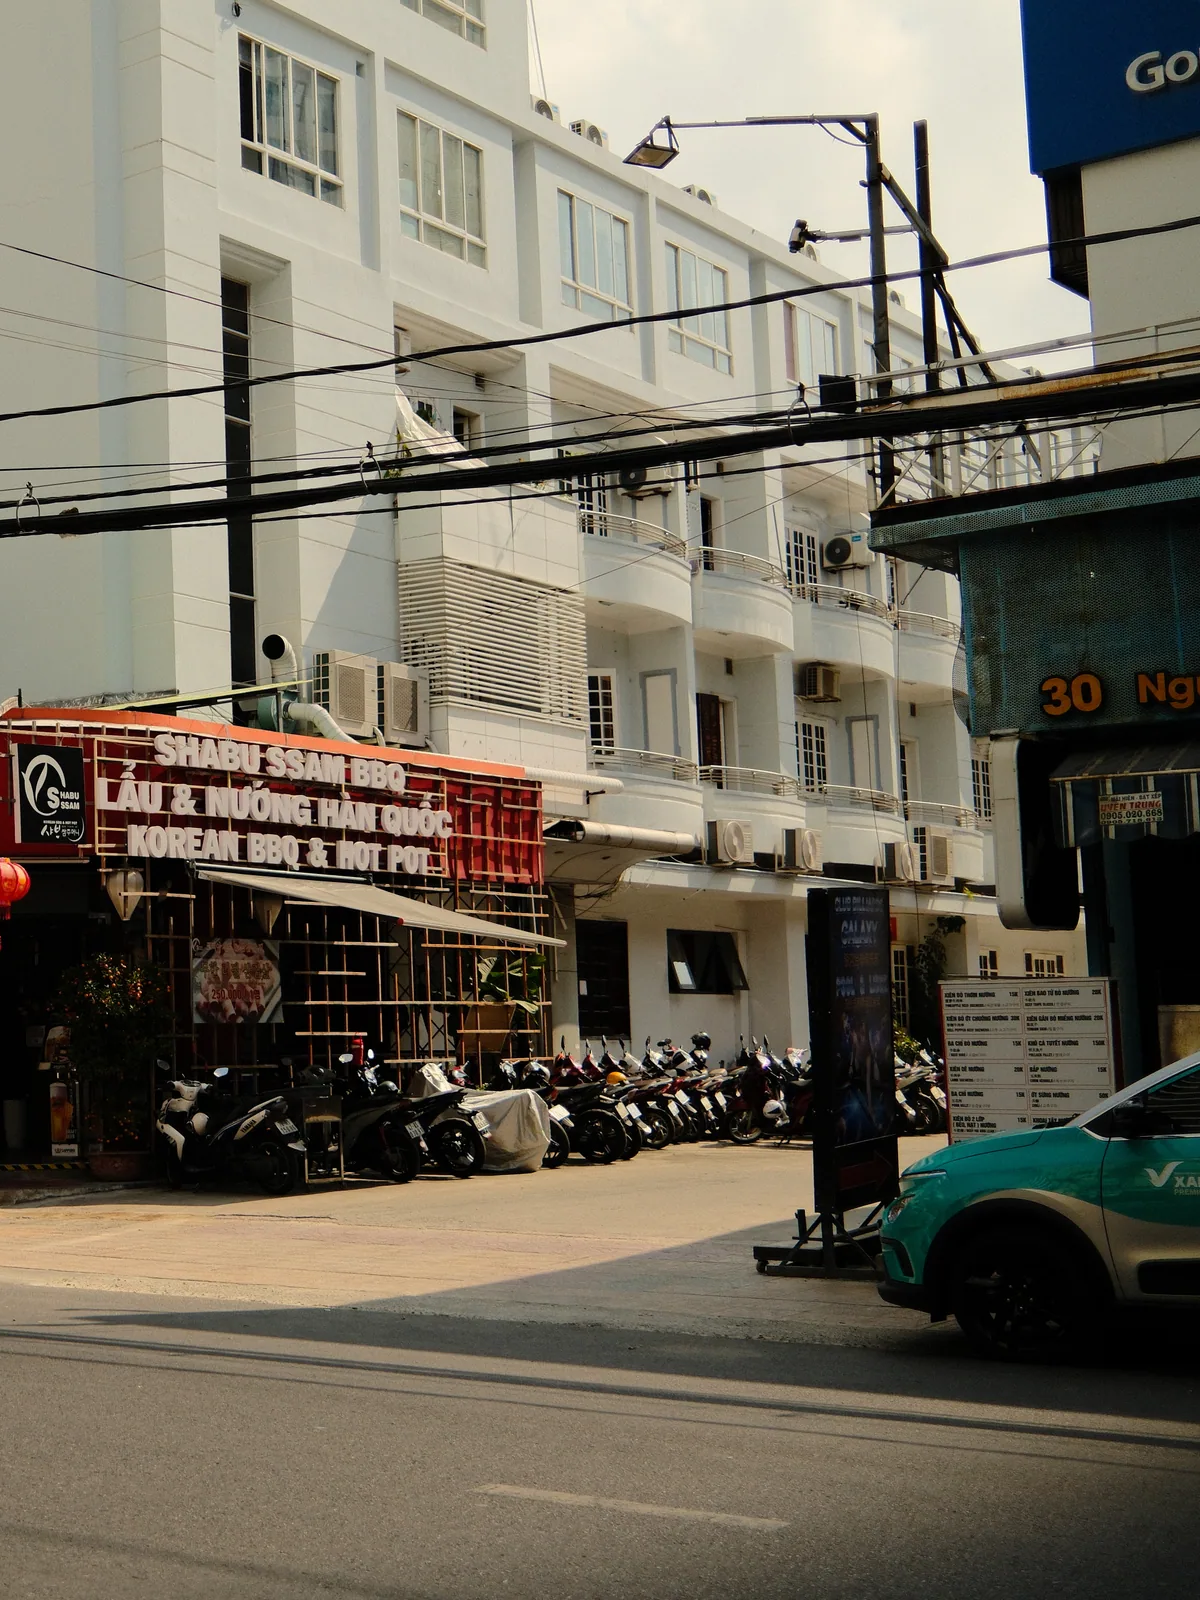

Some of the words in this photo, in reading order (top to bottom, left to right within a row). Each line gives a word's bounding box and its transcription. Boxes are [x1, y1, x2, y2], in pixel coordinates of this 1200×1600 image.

[1125, 50, 1200, 92] GO
[1040, 673, 1103, 717] 30
[153, 734, 260, 774] SHABU
[265, 746, 345, 785] SSAM
[351, 757, 407, 796] BBQ
[60, 801, 80, 810] SSAM
[95, 761, 163, 814] LẨU
[171, 784, 198, 816] &
[205, 780, 312, 827] NƯỚNG
[317, 791, 377, 832] HÀN
[381, 792, 454, 838] QUỐC
[127, 824, 240, 862] KOREAN
[247, 832, 300, 870] BBQ
[306, 837, 329, 869] &
[336, 840, 382, 872] HOT
[387, 844, 434, 876] POT
